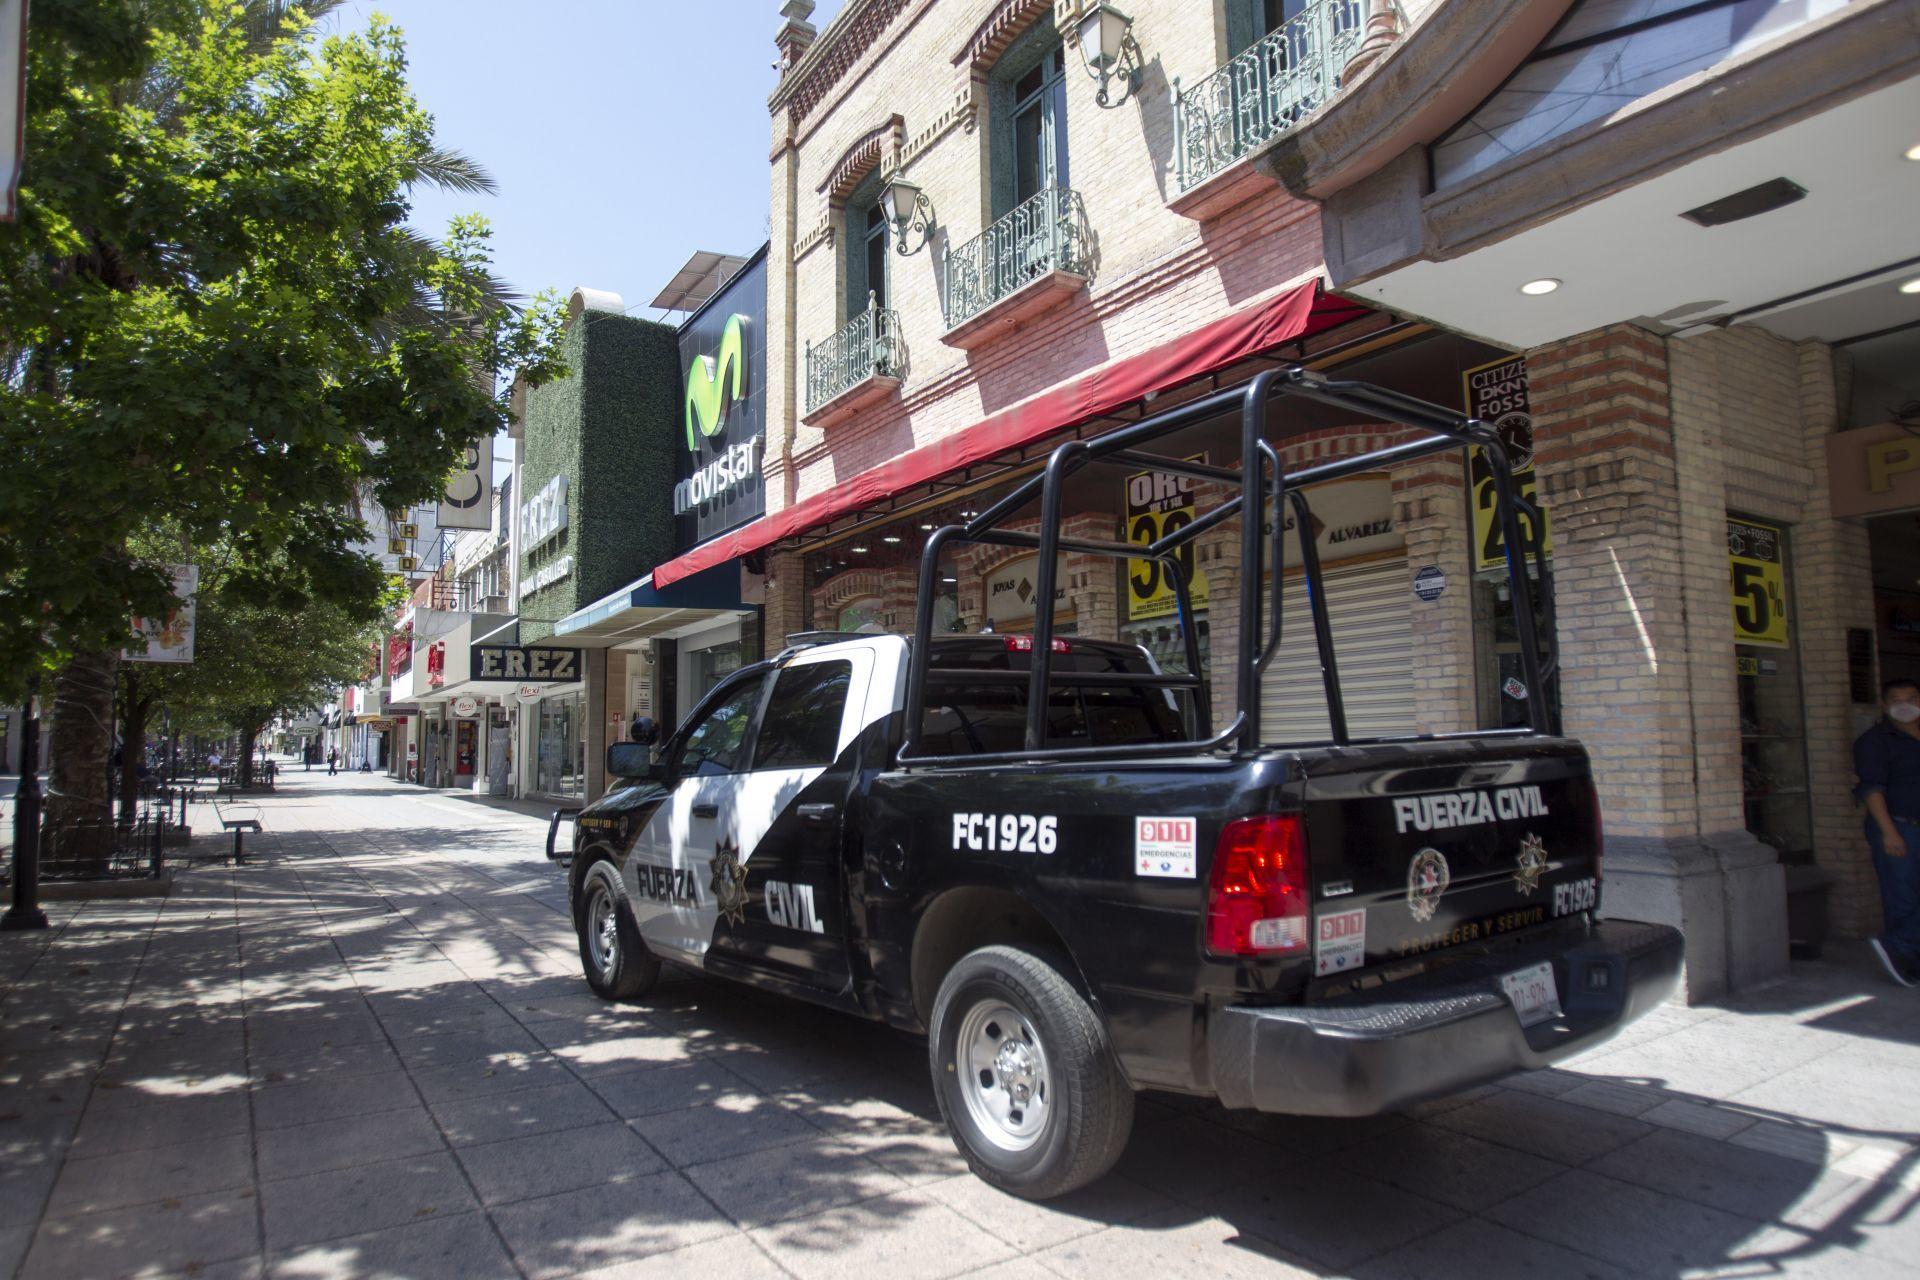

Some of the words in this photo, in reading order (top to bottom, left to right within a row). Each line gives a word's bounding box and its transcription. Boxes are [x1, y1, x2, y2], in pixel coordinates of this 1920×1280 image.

[674, 433, 762, 515] movistar
[1328, 520, 1392, 544] ALVAREZ
[1131, 511, 1195, 600] 30
[992, 580, 1015, 597] JOYAS
[481, 649, 574, 678] EREZ
[520, 686, 541, 698] flexi
[1394, 790, 1496, 834] FUERZA
[1497, 785, 1549, 821] CIVIL
[953, 813, 1058, 855] FC1926
[1141, 821, 1191, 842] 911
[1140, 849, 1192, 859] EMERGENCIAS
[637, 863, 700, 909] FUERZA
[1553, 878, 1596, 918] FC1926
[764, 880, 825, 935] CIVIL
[1322, 914, 1362, 939] 911
[1400, 921, 1479, 957] PROTEGER
[1483, 917, 1493, 937] Y
[1497, 906, 1544, 933] SERVIR
